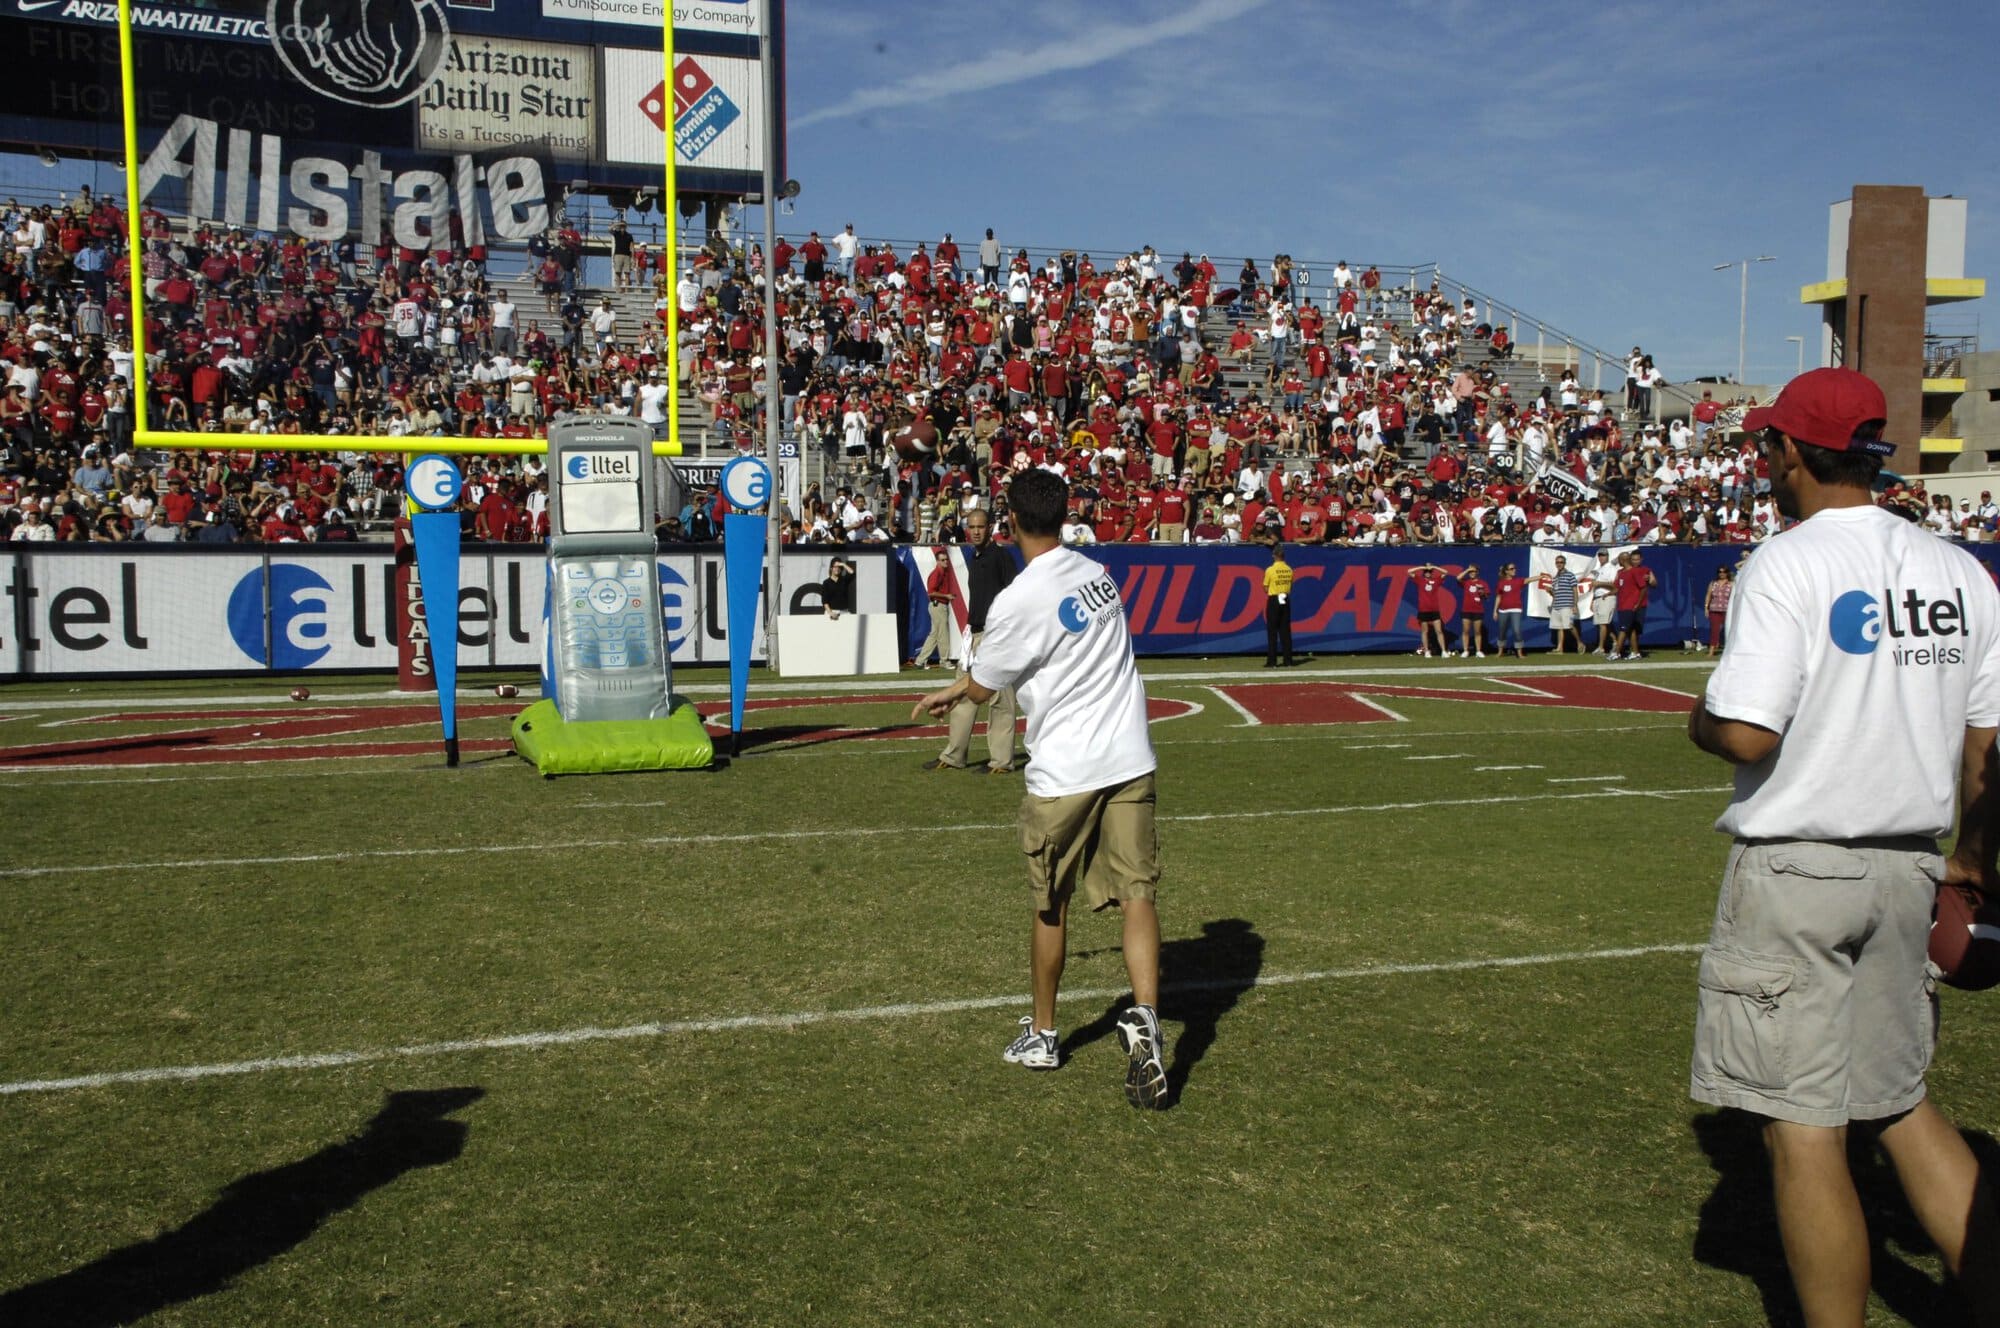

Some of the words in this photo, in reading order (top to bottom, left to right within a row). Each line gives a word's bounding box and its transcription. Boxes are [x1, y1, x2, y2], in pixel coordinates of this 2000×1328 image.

[693, 8, 755, 25] Company
[445, 39, 572, 80] Arizona
[421, 78, 510, 122] Daily
[519, 84, 592, 119] Star
[422, 122, 448, 139] It's
[454, 130, 465, 140] a
[471, 126, 535, 145] Tucson
[681, 125, 717, 157] Pizza
[138, 113, 549, 252] Allstate
[1298, 271, 1309, 284] 30
[778, 443, 796, 456] 29
[578, 455, 631, 475] alltel
[1496, 455, 1514, 467] 30
